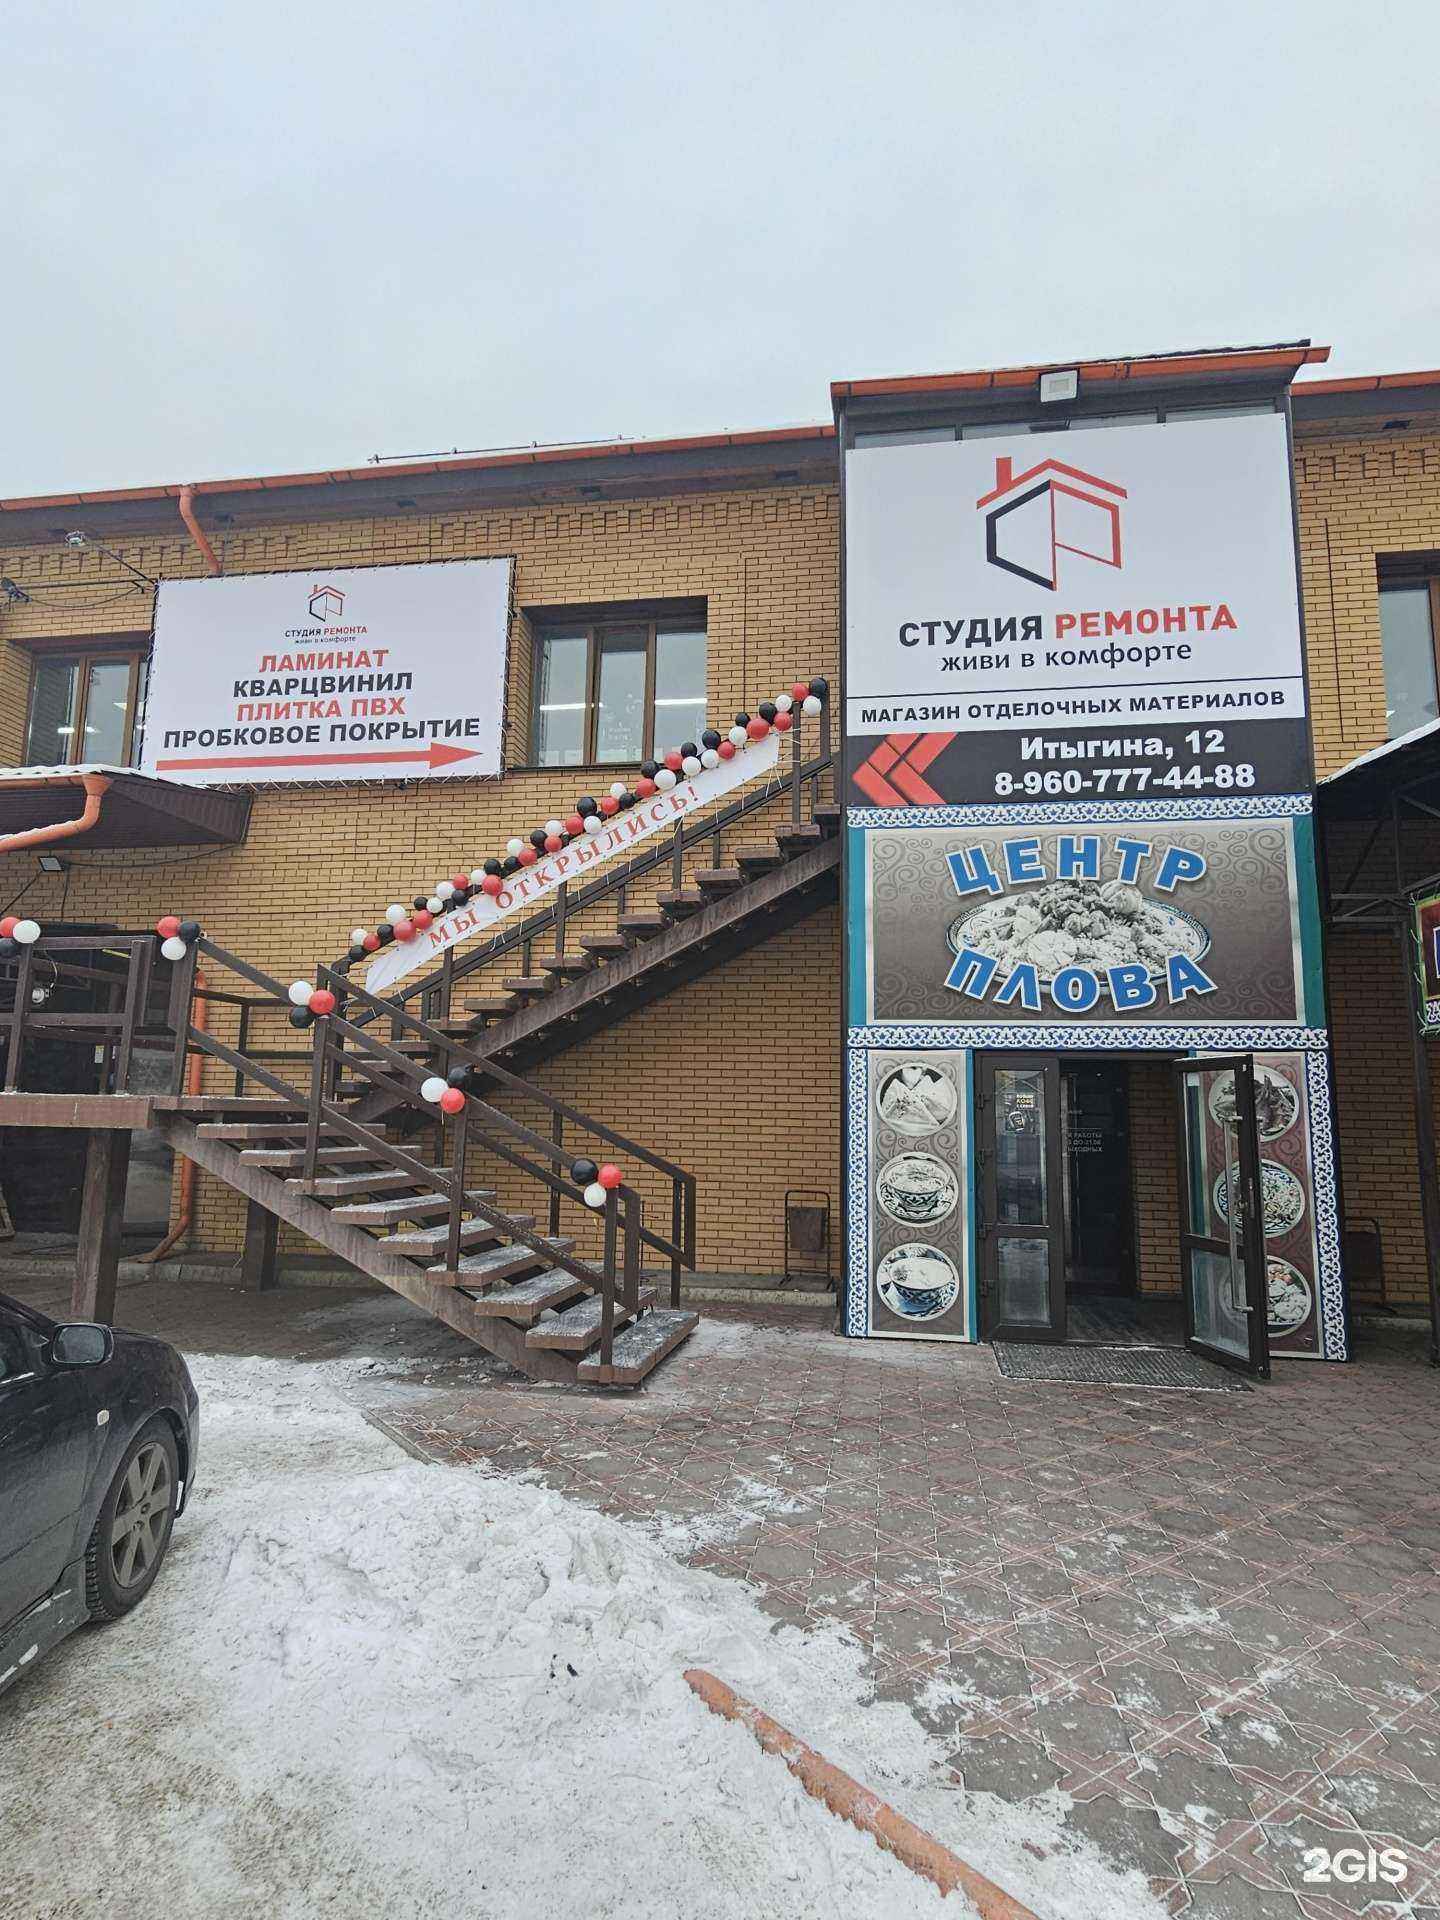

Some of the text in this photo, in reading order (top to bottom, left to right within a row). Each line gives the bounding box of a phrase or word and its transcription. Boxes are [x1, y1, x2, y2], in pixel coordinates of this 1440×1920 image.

[284, 626, 368, 638] СТУДИЯ РЕМОНТА
[898, 604, 1238, 648] СТУДИЯ РЕМОНТА
[258, 649, 390, 673] ЛАМИНАТ
[940, 642, 1193, 672] живи в комфорте
[233, 672, 414, 698] КВАРЦВИНИЛ
[236, 696, 406, 722] ПЛИТКА ПВХ
[861, 690, 1286, 724] МАГАЗИН ОТДЕЛОЧНЫХ МАТЕРИАЛОВ
[163, 717, 481, 749] ПРОБКОВОЕ ПОКРЫТИЕ
[1020, 729, 1225, 761] Итыгина, 12
[994, 763, 1256, 797] 8-960-777-44-88
[427, 785, 700, 949] МЫ ОТКРЫЛИСЬ!
[945, 834, 1207, 897] ЦЕНТР
[943, 947, 1219, 1013] ПЛОВА
